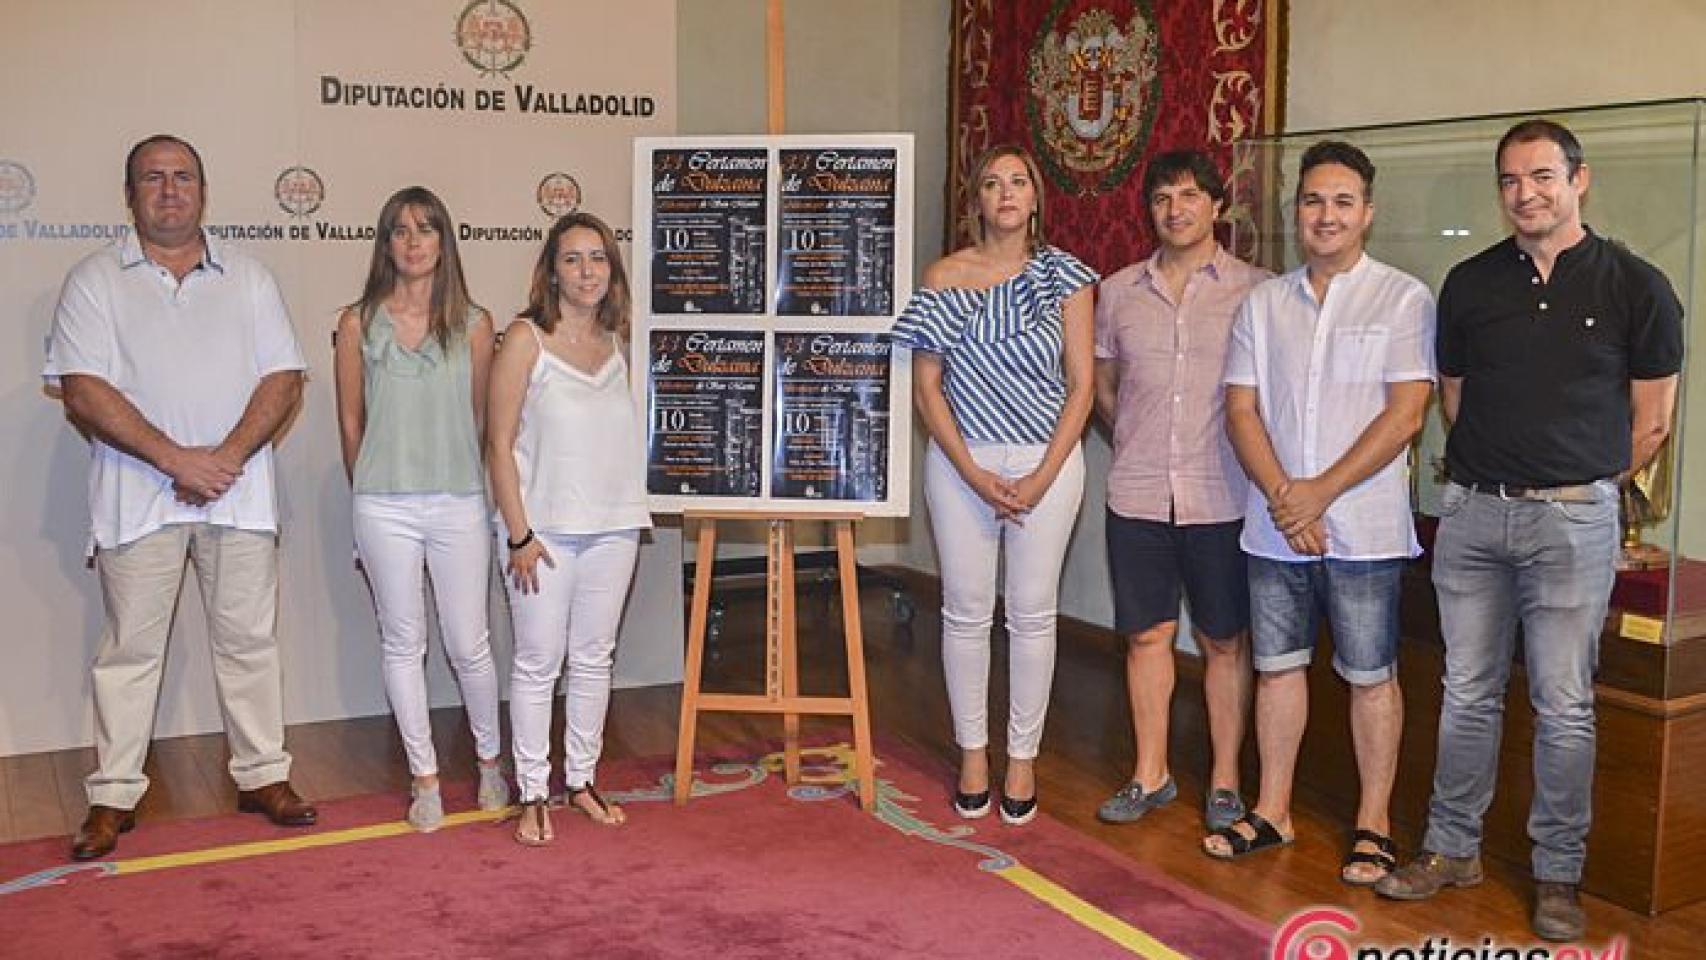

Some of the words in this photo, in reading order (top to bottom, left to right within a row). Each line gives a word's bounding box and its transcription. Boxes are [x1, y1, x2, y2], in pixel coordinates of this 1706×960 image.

[321, 76, 464, 109] DIPUTACIÓN
[475, 90, 505, 110] DE
[515, 85, 656, 116] VALLADOLID
[689, 151, 767, 170] Certamen
[816, 151, 895, 170] Certamen
[654, 173, 675, 191] de
[781, 173, 802, 191] de
[24, 220, 129, 239] VALLADOLID
[289, 225, 310, 239] DE
[316, 222, 377, 241] VALLAD
[459, 222, 543, 241] DIPUTACIÓN
[664, 229, 689, 250] 10
[791, 229, 815, 252] 10
[686, 332, 763, 352] Certamen
[811, 334, 891, 354] Certamen
[651, 353, 672, 373] de
[783, 356, 797, 375] de
[661, 410, 685, 431] 10
[786, 413, 810, 433] 10
